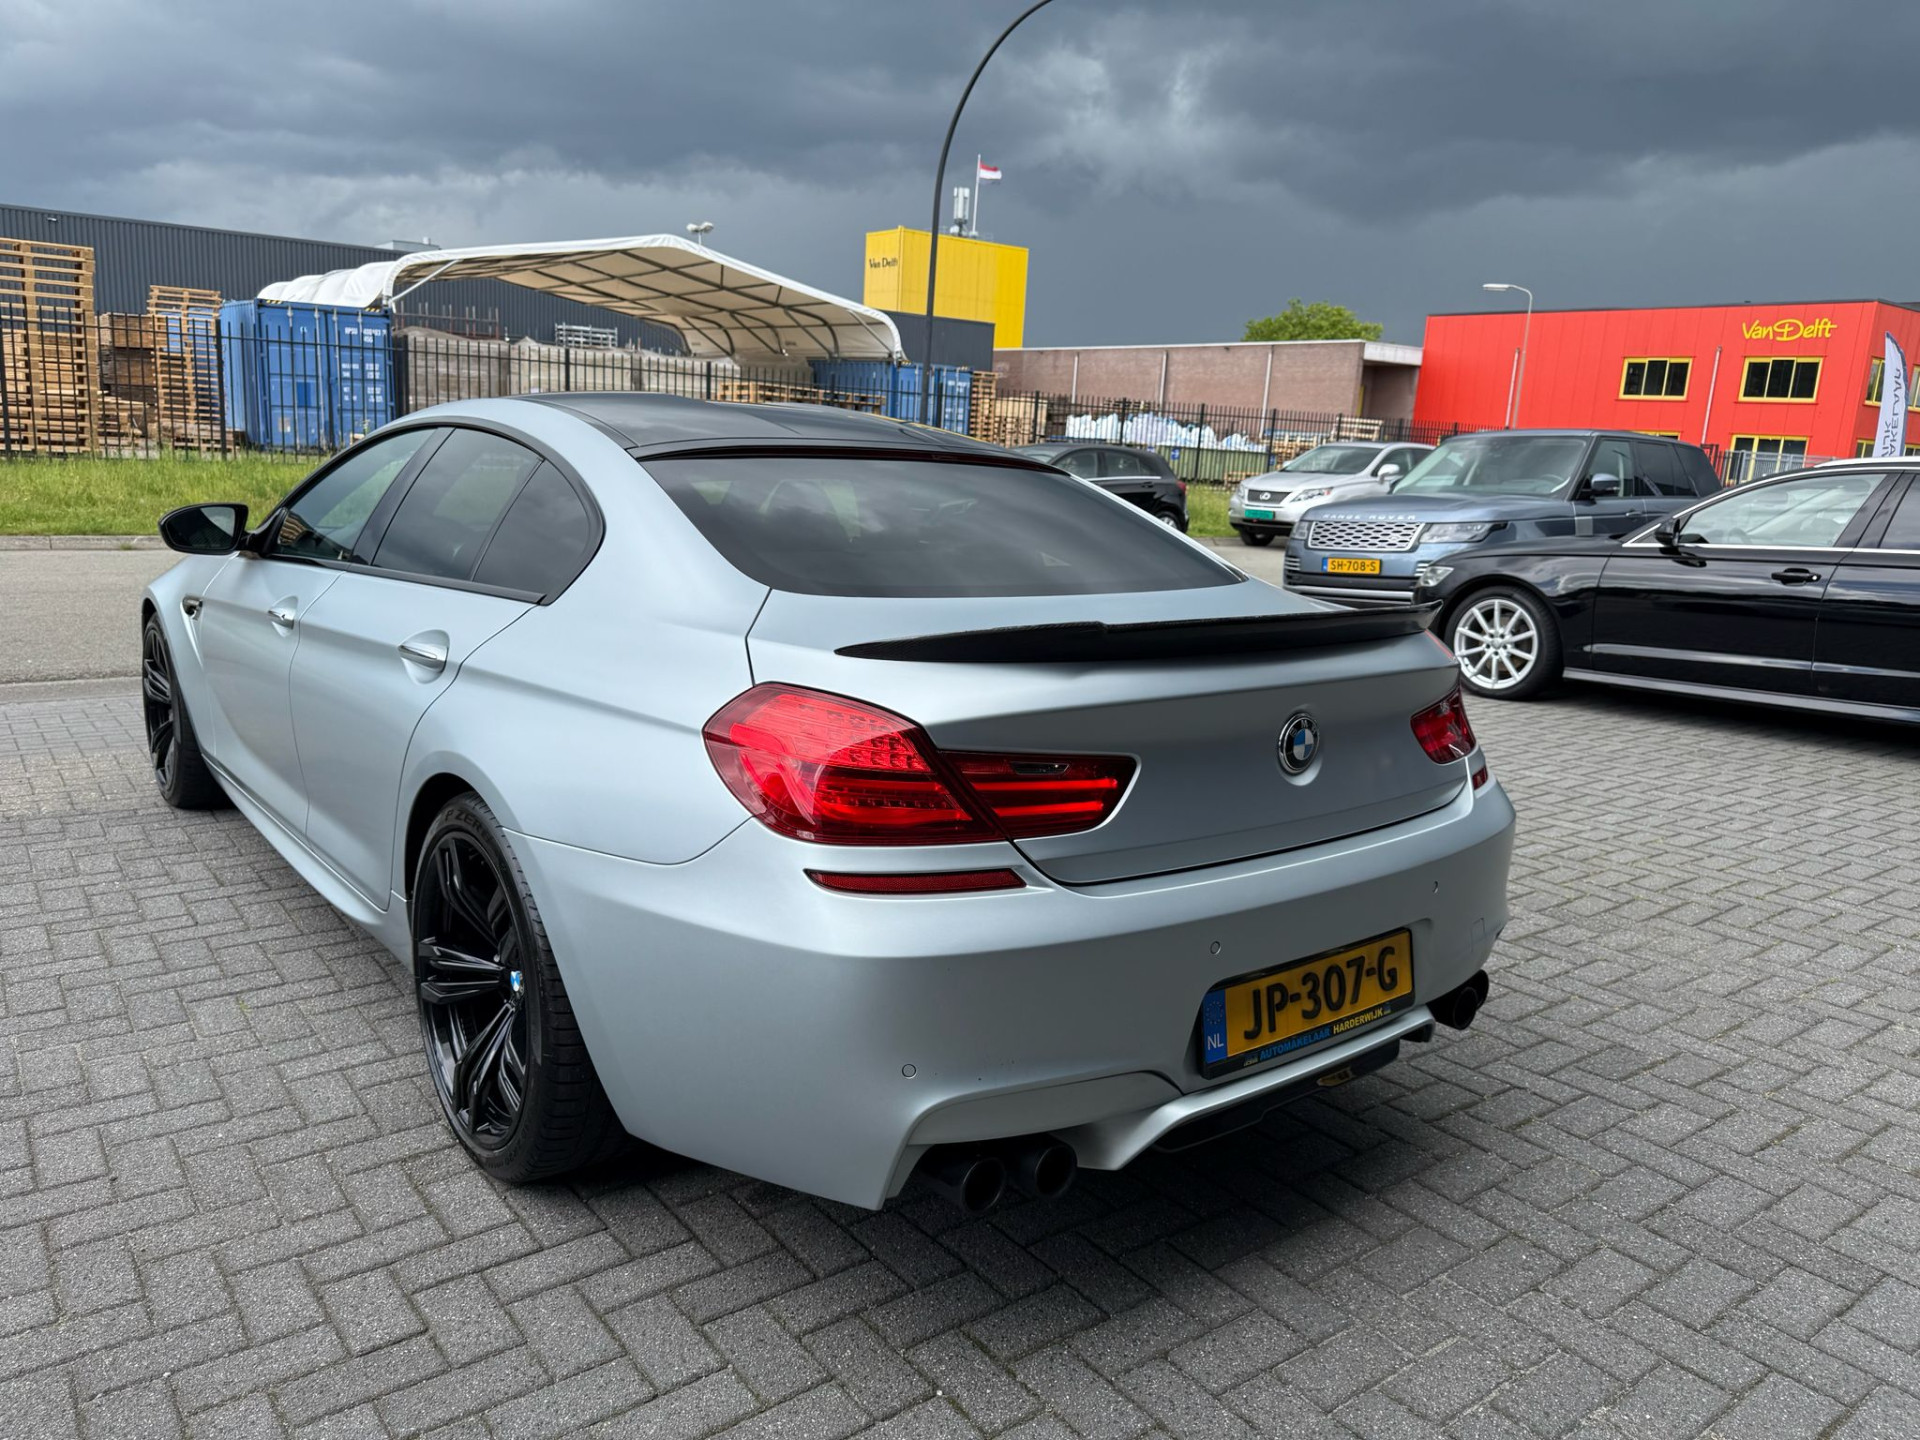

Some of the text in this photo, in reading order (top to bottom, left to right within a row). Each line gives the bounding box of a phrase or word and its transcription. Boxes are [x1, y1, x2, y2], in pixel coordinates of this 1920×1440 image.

[1330, 560, 1377, 572] SH-708-S
[1243, 946, 1398, 1040] JP-307-G
[1207, 1034, 1224, 1050] NL
[1260, 1007, 1384, 1061] AUTOMAKELAAR HARDERWIJK
